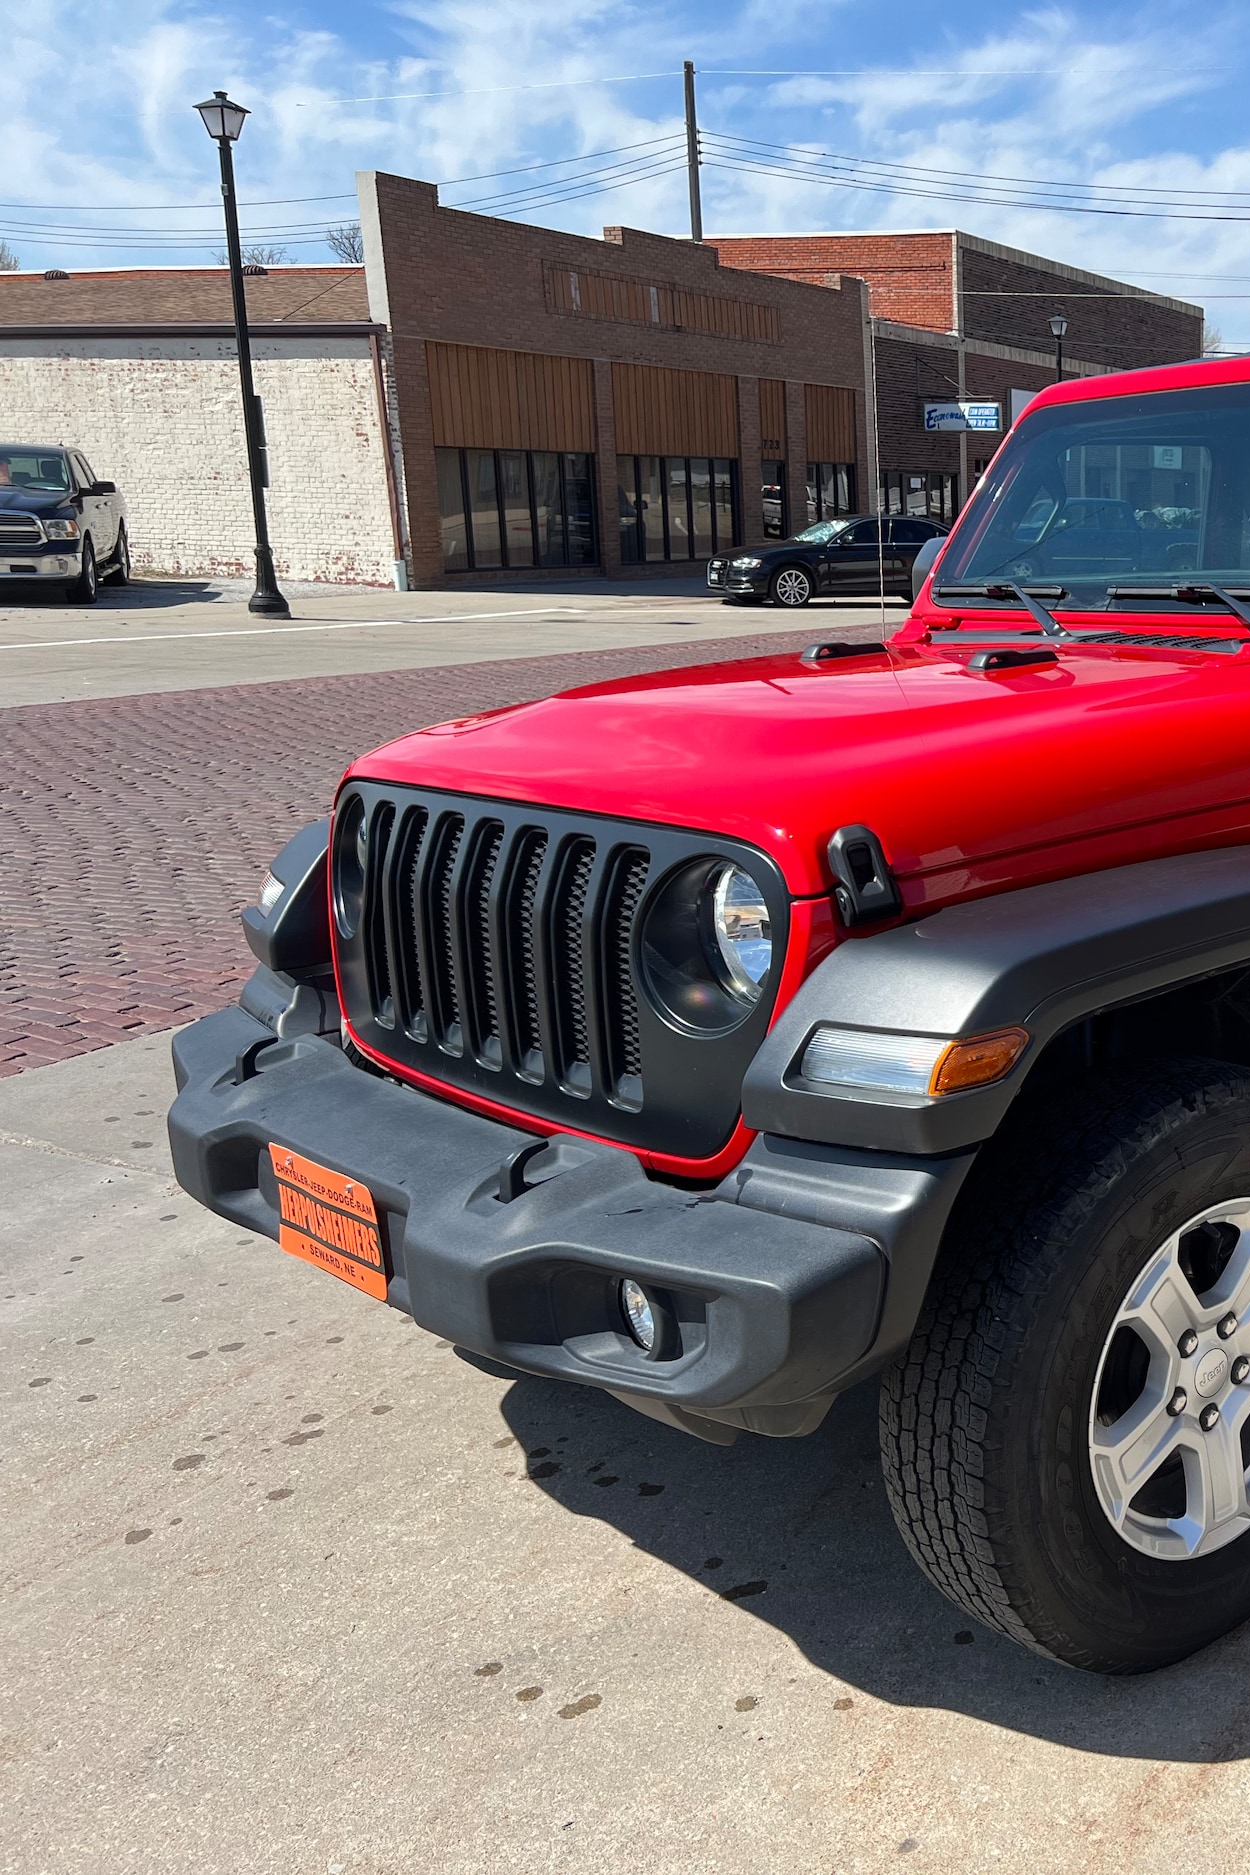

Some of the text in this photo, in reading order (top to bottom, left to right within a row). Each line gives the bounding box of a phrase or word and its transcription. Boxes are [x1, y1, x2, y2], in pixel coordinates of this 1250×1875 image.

[762, 439, 780, 450] 723
[309, 1244, 356, 1277] SEWARD, NE
[1200, 1360, 1226, 1387] Jeep
